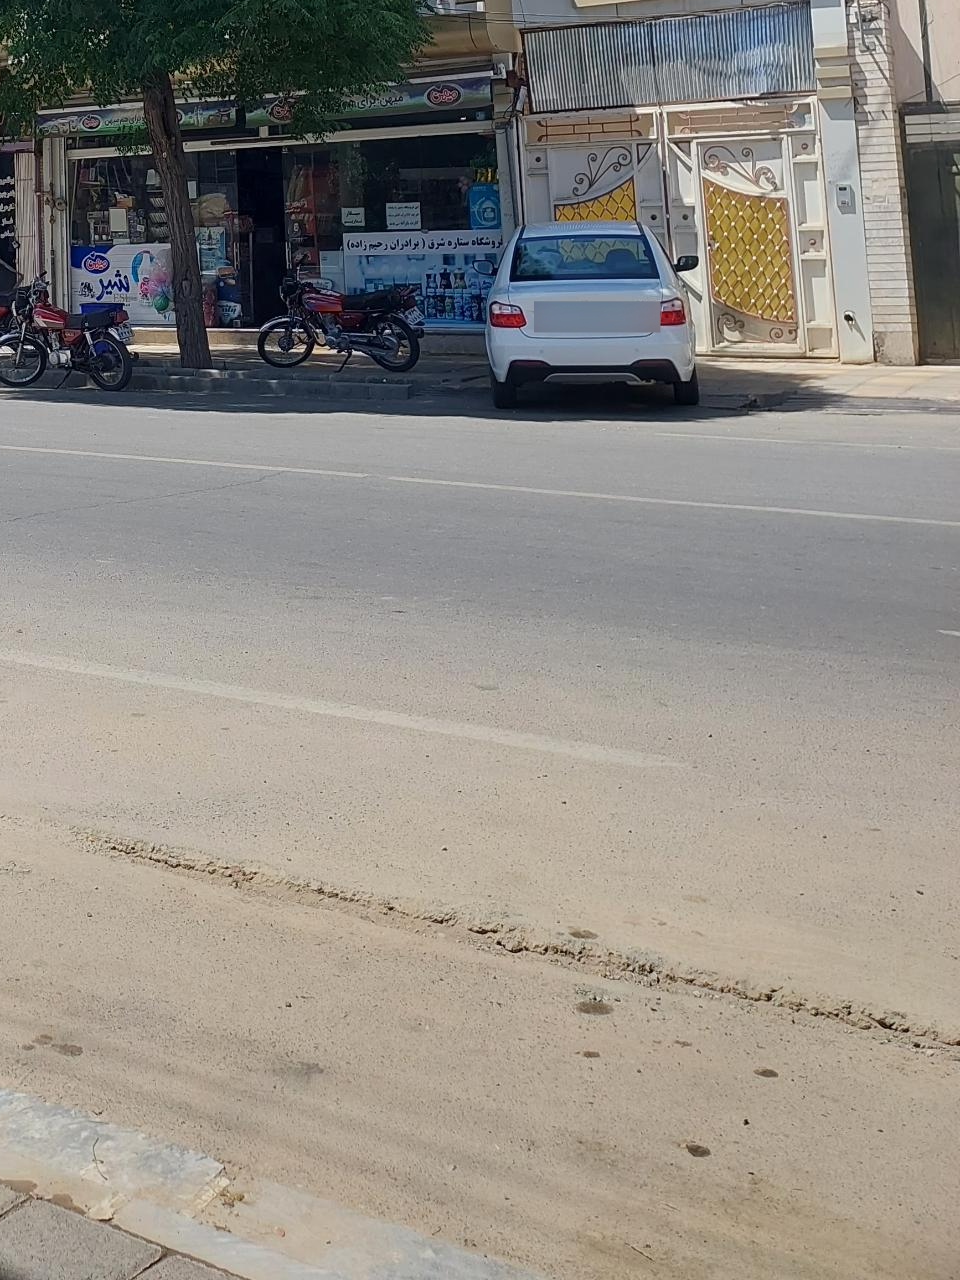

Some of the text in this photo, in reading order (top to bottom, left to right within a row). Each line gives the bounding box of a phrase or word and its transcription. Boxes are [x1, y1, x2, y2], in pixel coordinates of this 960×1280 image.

[368, 239, 388, 252] رحیم
[427, 238, 445, 251] شرق
[448, 236, 470, 250] ستاره
[96, 269, 130, 301] شیر
